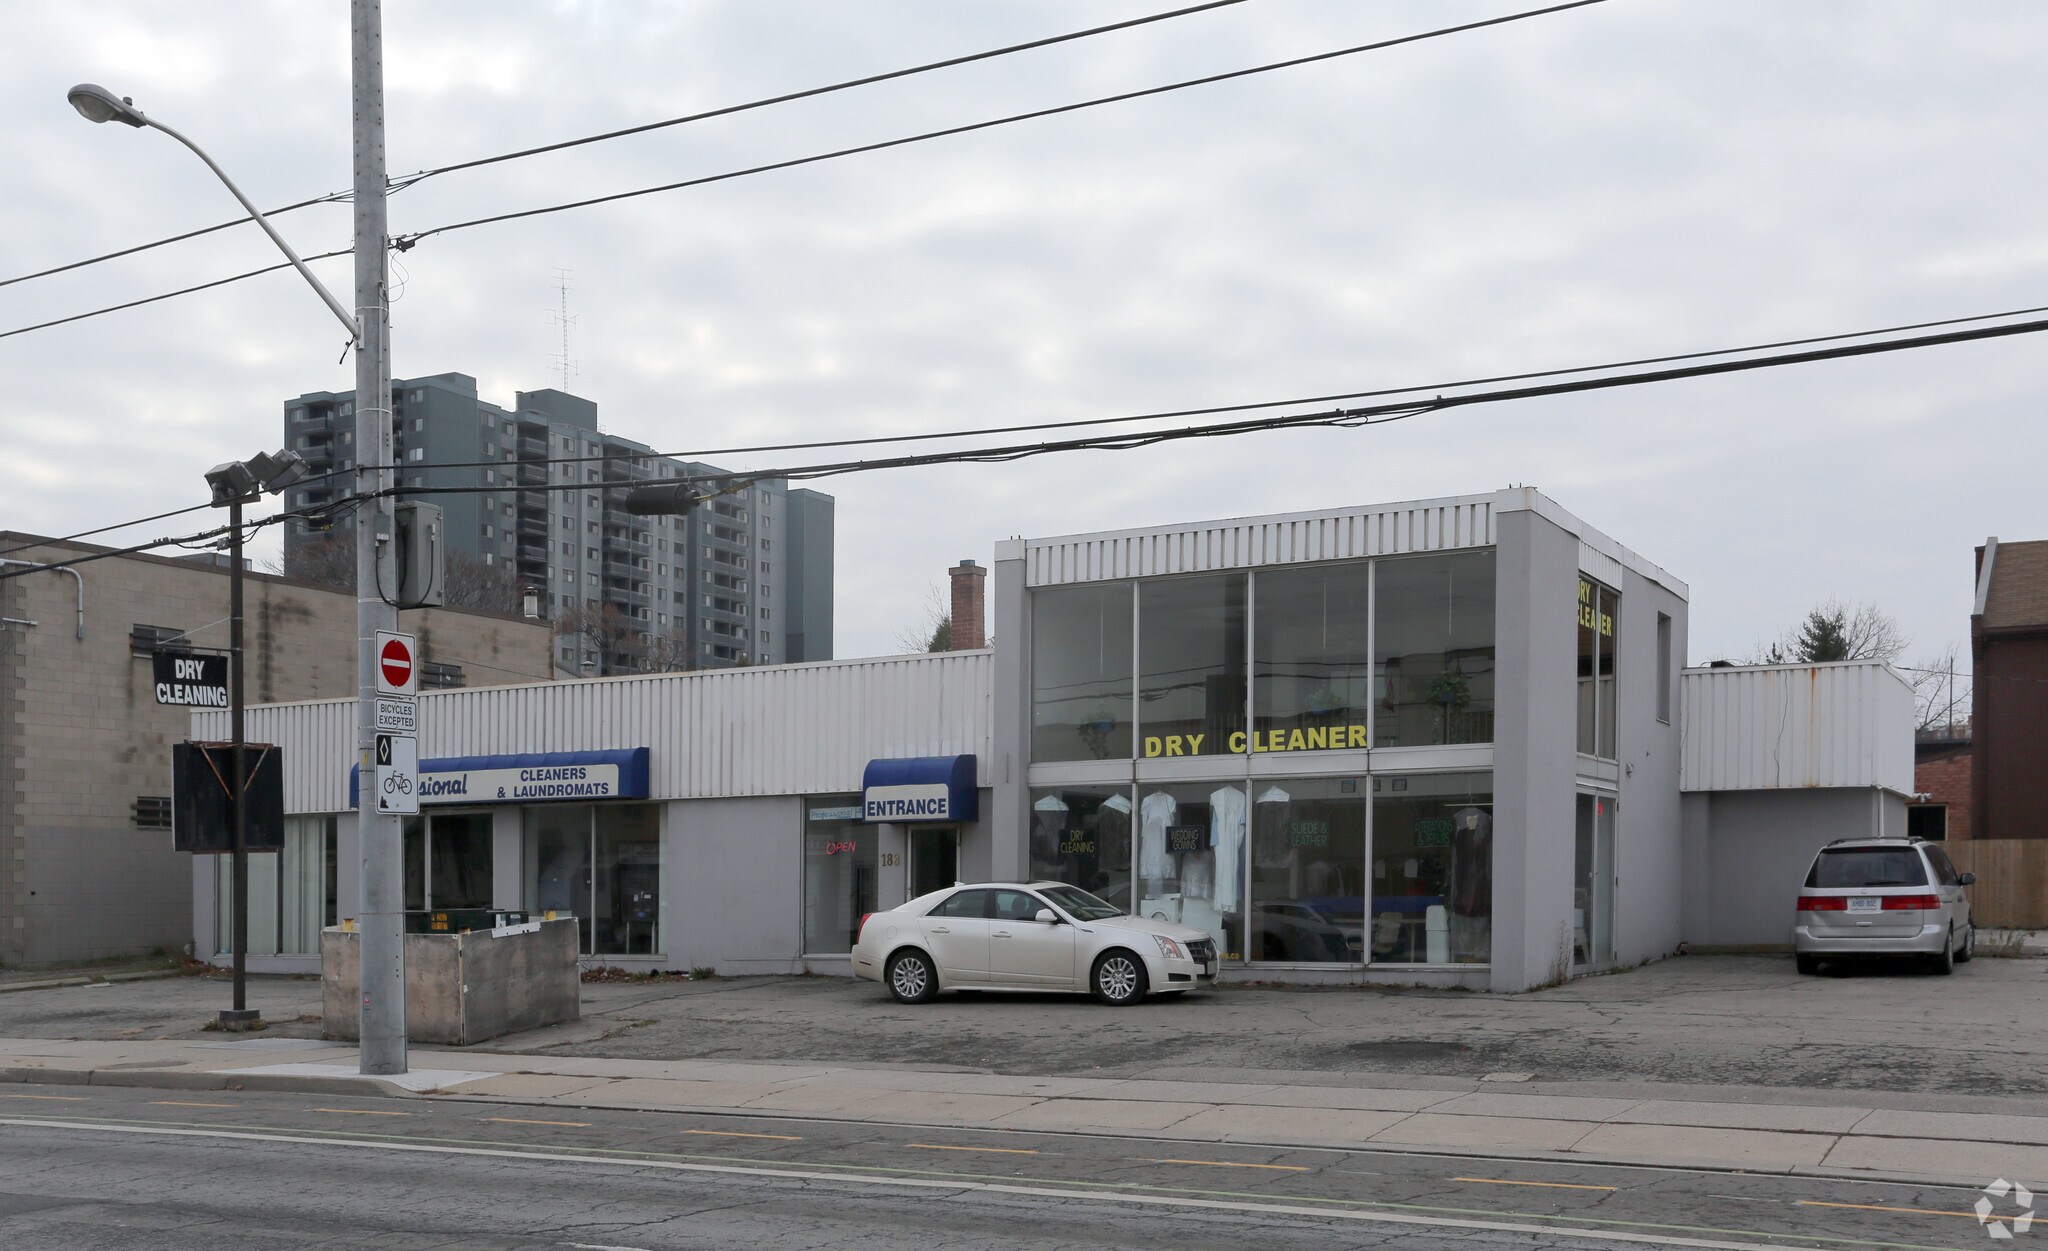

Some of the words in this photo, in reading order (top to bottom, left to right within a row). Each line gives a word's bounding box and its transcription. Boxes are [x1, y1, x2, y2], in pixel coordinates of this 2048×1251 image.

[1578, 579, 1591, 604] RY
[175, 658, 205, 680] DRY
[156, 682, 228, 707] CLEANING
[380, 703, 413, 716] BICYCLES
[379, 715, 414, 727] EXCEPTED
[1145, 734, 1205, 758] DRY
[1229, 725, 1368, 754] CLEANER
[520, 767, 587, 782] CLEANERS
[419, 773, 468, 796] sional
[497, 786, 506, 799] &
[513, 782, 609, 798] LAUNDROMATS
[867, 798, 947, 817] ENTRANCE
[1171, 829, 1199, 841] WEDDING
[1291, 822, 1318, 835] SUEDE
[1320, 823, 1328, 835] &
[1070, 830, 1085, 842] DRY
[1291, 834, 1327, 847] LEATHER
[826, 841, 856, 855] OPEN
[1060, 841, 1095, 854] CLEANING
[1172, 839, 1196, 851] GOWNS
